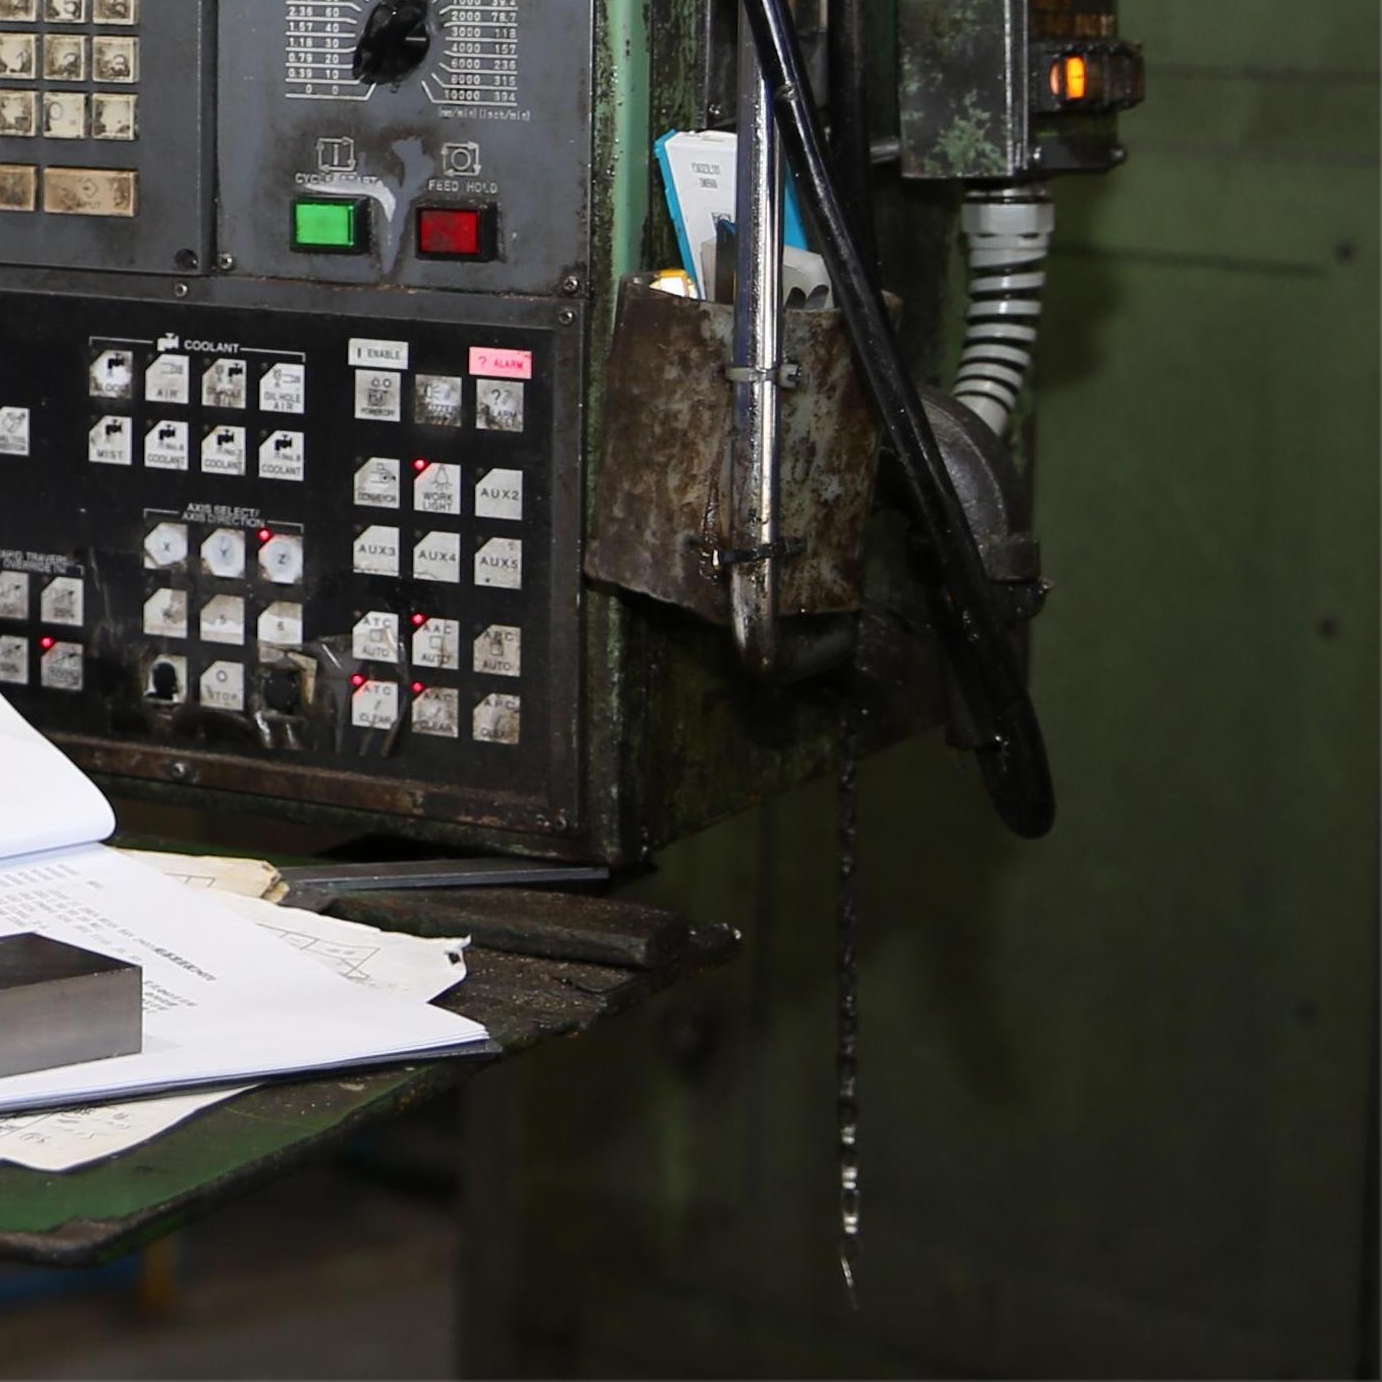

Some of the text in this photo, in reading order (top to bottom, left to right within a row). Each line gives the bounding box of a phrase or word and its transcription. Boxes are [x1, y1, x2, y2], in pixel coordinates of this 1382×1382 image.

[428, 180, 459, 192] FEED
[184, 340, 240, 353] COOLANT
[367, 349, 401, 361] ENABLE
[494, 358, 523, 369] ALARM
[156, 388, 178, 398] AIR
[97, 450, 123, 460] MIST
[261, 463, 301, 475] COOLANT
[422, 492, 452, 501] WORK
[480, 488, 519, 501] AUX2
[423, 502, 452, 512] LIGHT
[358, 544, 396, 556] AUX3
[418, 549, 456, 562] AUX4
[479, 556, 518, 569] AUX5
[362, 618, 392, 629] ATC
[362, 647, 390, 657] AUTO
[363, 685, 391, 696] ATC
